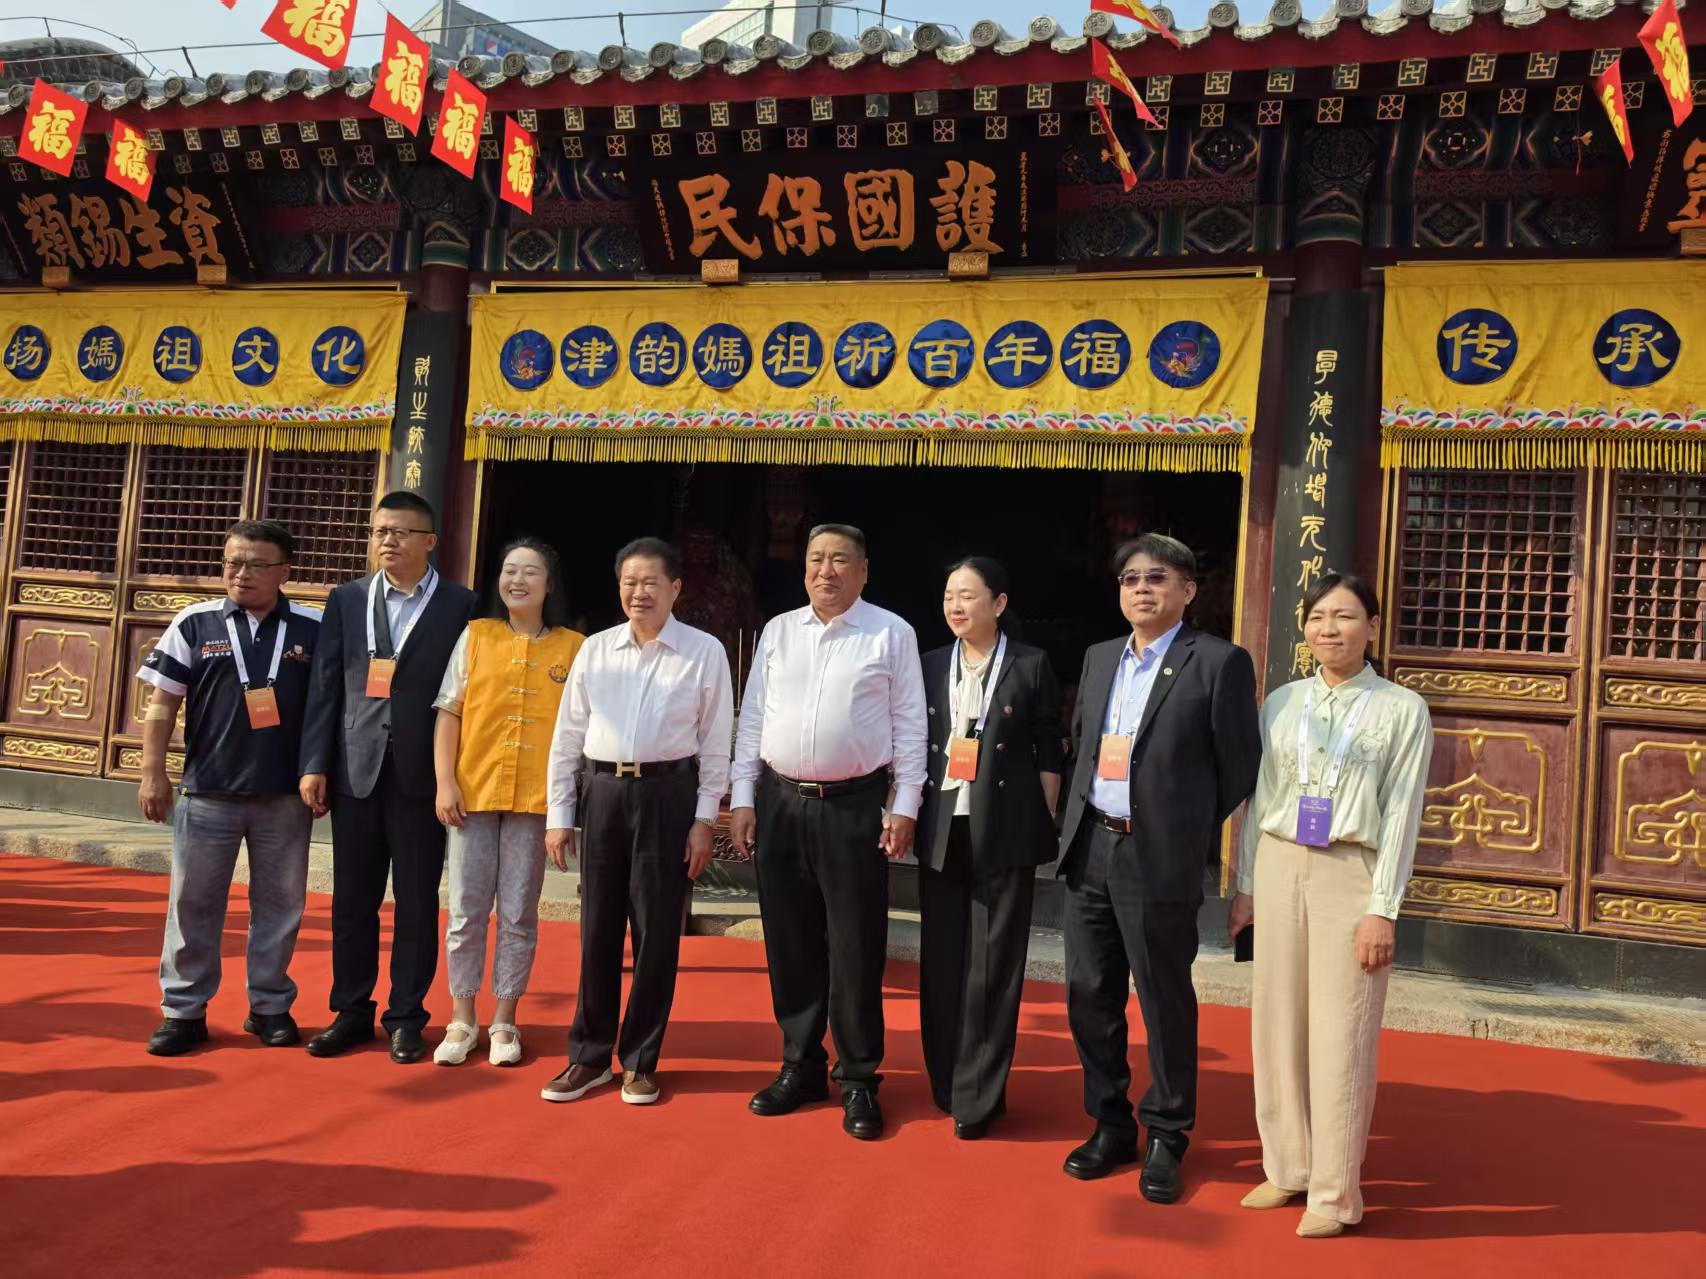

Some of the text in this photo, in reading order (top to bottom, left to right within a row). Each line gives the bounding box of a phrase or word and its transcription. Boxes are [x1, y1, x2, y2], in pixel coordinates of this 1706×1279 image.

[284, 0, 350, 56] 福
[385, 40, 424, 115] 福
[28, 101, 75, 158] 福
[442, 92, 478, 160] 福
[114, 128, 149, 185] 福
[507, 137, 534, 198] 福
[565, 331, 1122, 379] 津韵媽祖祈百年福
[1442, 322, 1672, 373] 传承
